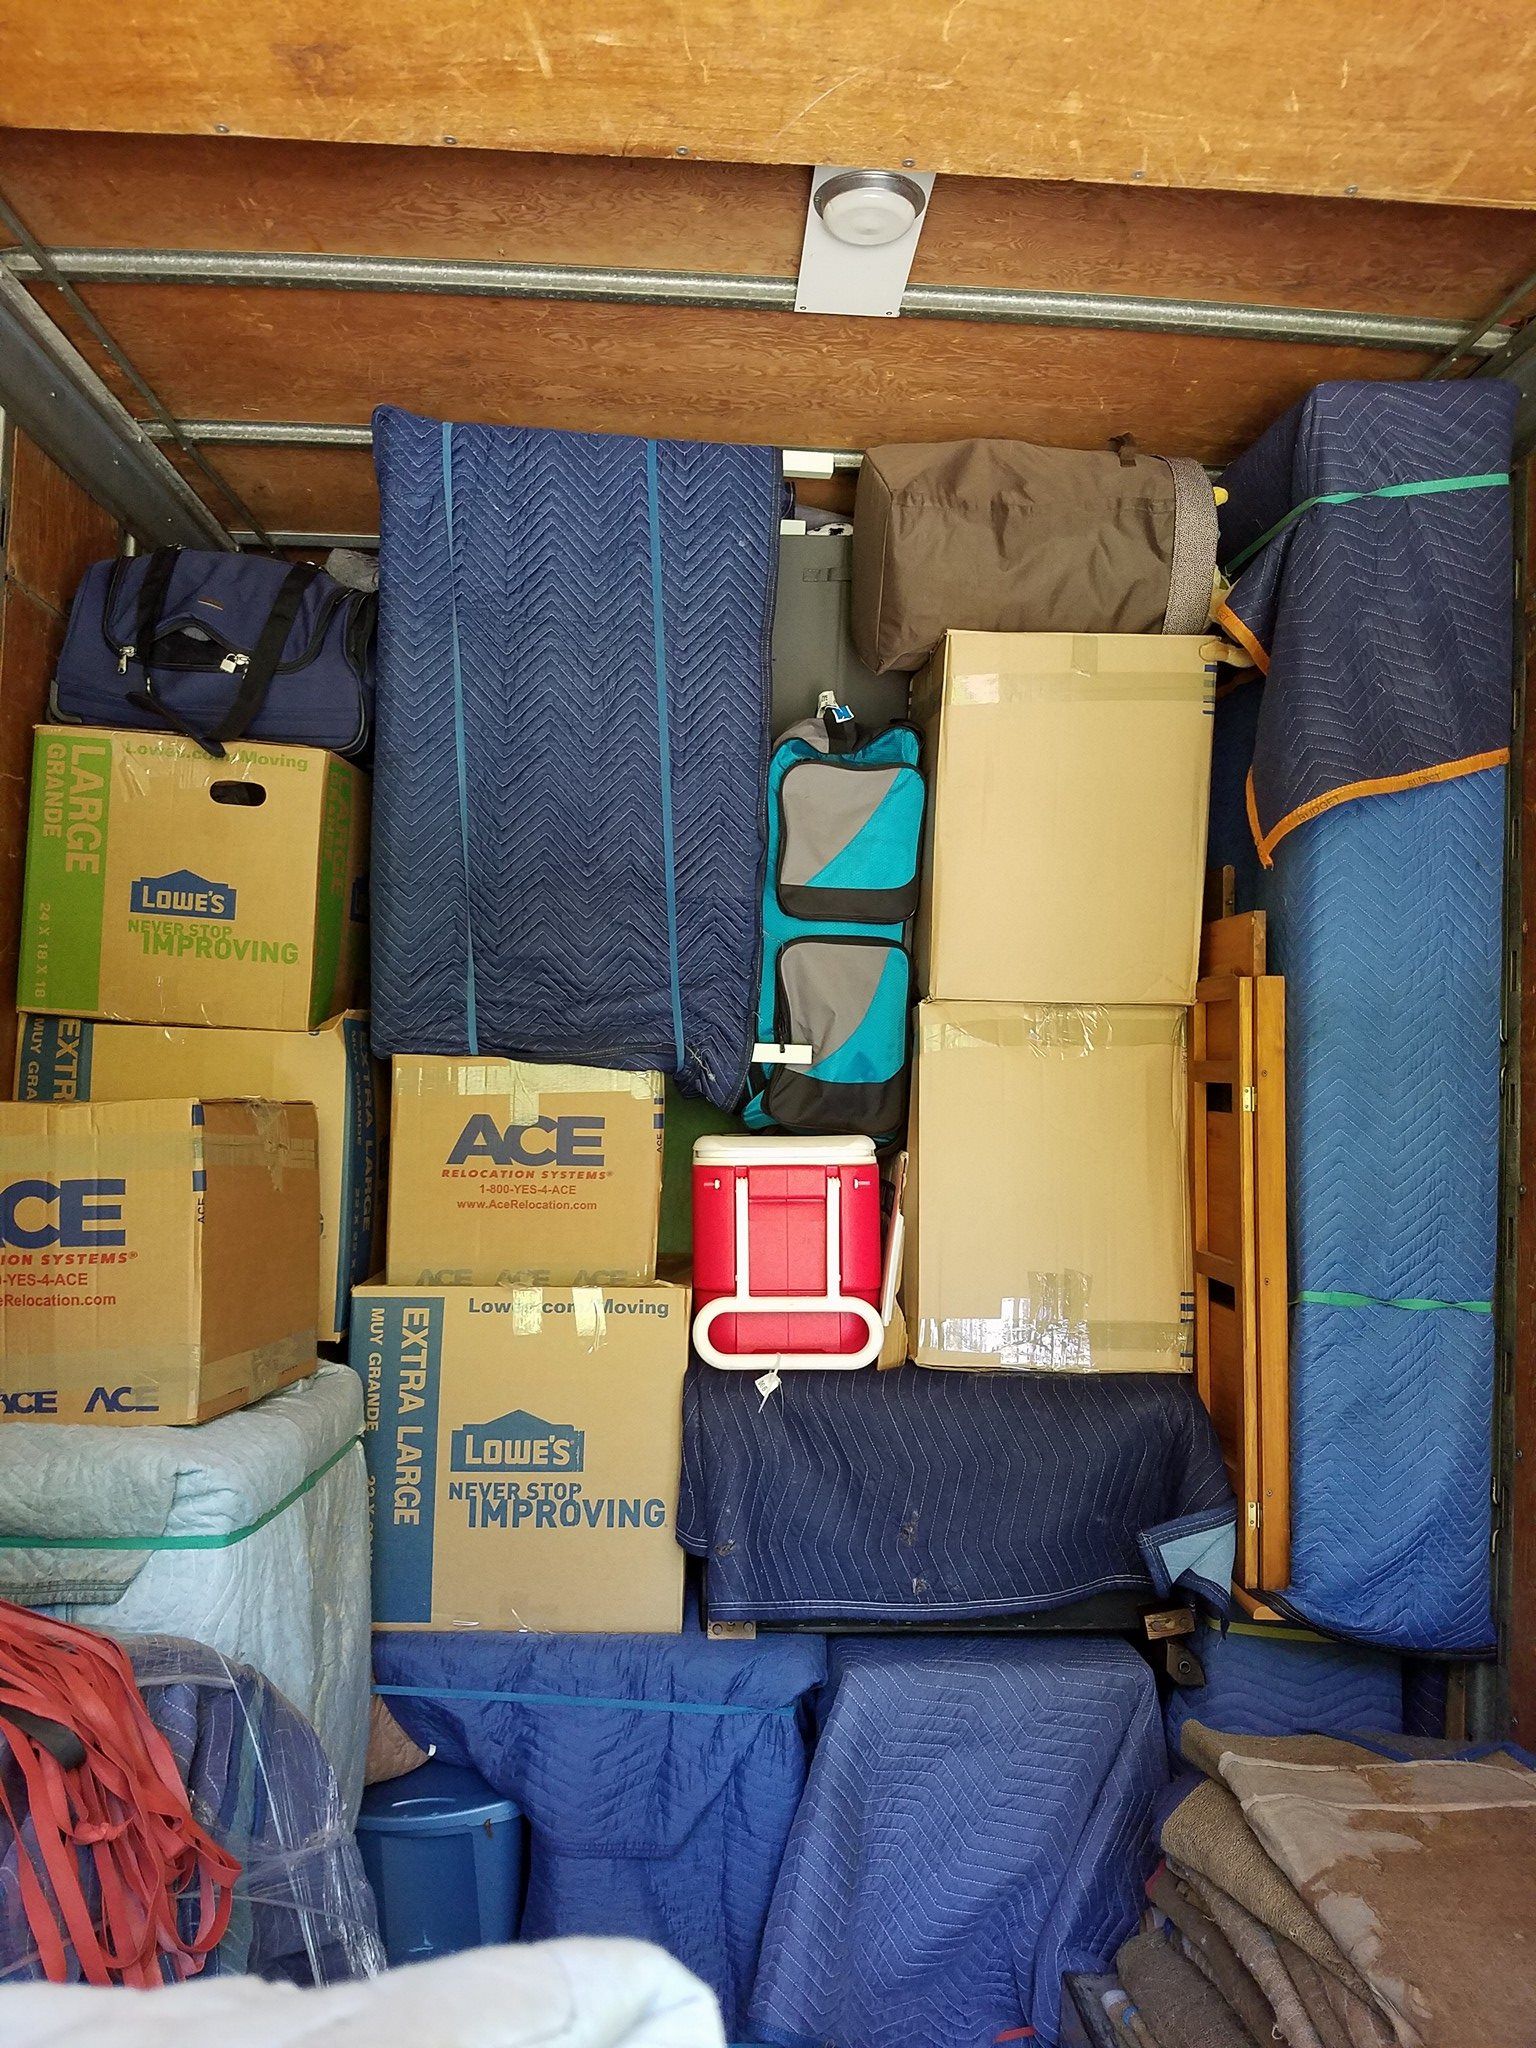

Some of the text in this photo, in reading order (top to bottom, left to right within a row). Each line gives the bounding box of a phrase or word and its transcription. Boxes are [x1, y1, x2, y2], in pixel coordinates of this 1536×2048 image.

[43, 743, 64, 838] GRANDE
[65, 744, 106, 874] LARGE
[40, 902, 51, 920] 24
[142, 885, 225, 914] LOWE'S
[128, 919, 232, 939] NEVER STOP
[142, 931, 299, 965] IMPROVING
[31, 1018, 45, 1054] MUY
[54, 1019, 81, 1100] EXTR
[27, 1061, 40, 1099] GRA
[446, 1113, 605, 1166] ACE
[441, 1169, 535, 1179] RELOCATION
[480, 1184, 576, 1195] 1-800-YES-4-ACE
[0, 1179, 125, 1249] CE
[457, 1199, 597, 1210] www.AceRelocation.com
[0, 1273, 88, 1286] -YES-4-ACE
[369, 1308, 385, 1346] MUY
[84, 1386, 160, 1413] ACE
[366, 1352, 382, 1432] GRANDE
[393, 1307, 429, 1525] EXTRA LARGE
[465, 1434, 571, 1466] LOWE'S
[449, 1482, 582, 1500] NEVER STOP
[468, 1498, 666, 1528] IMPROVING
